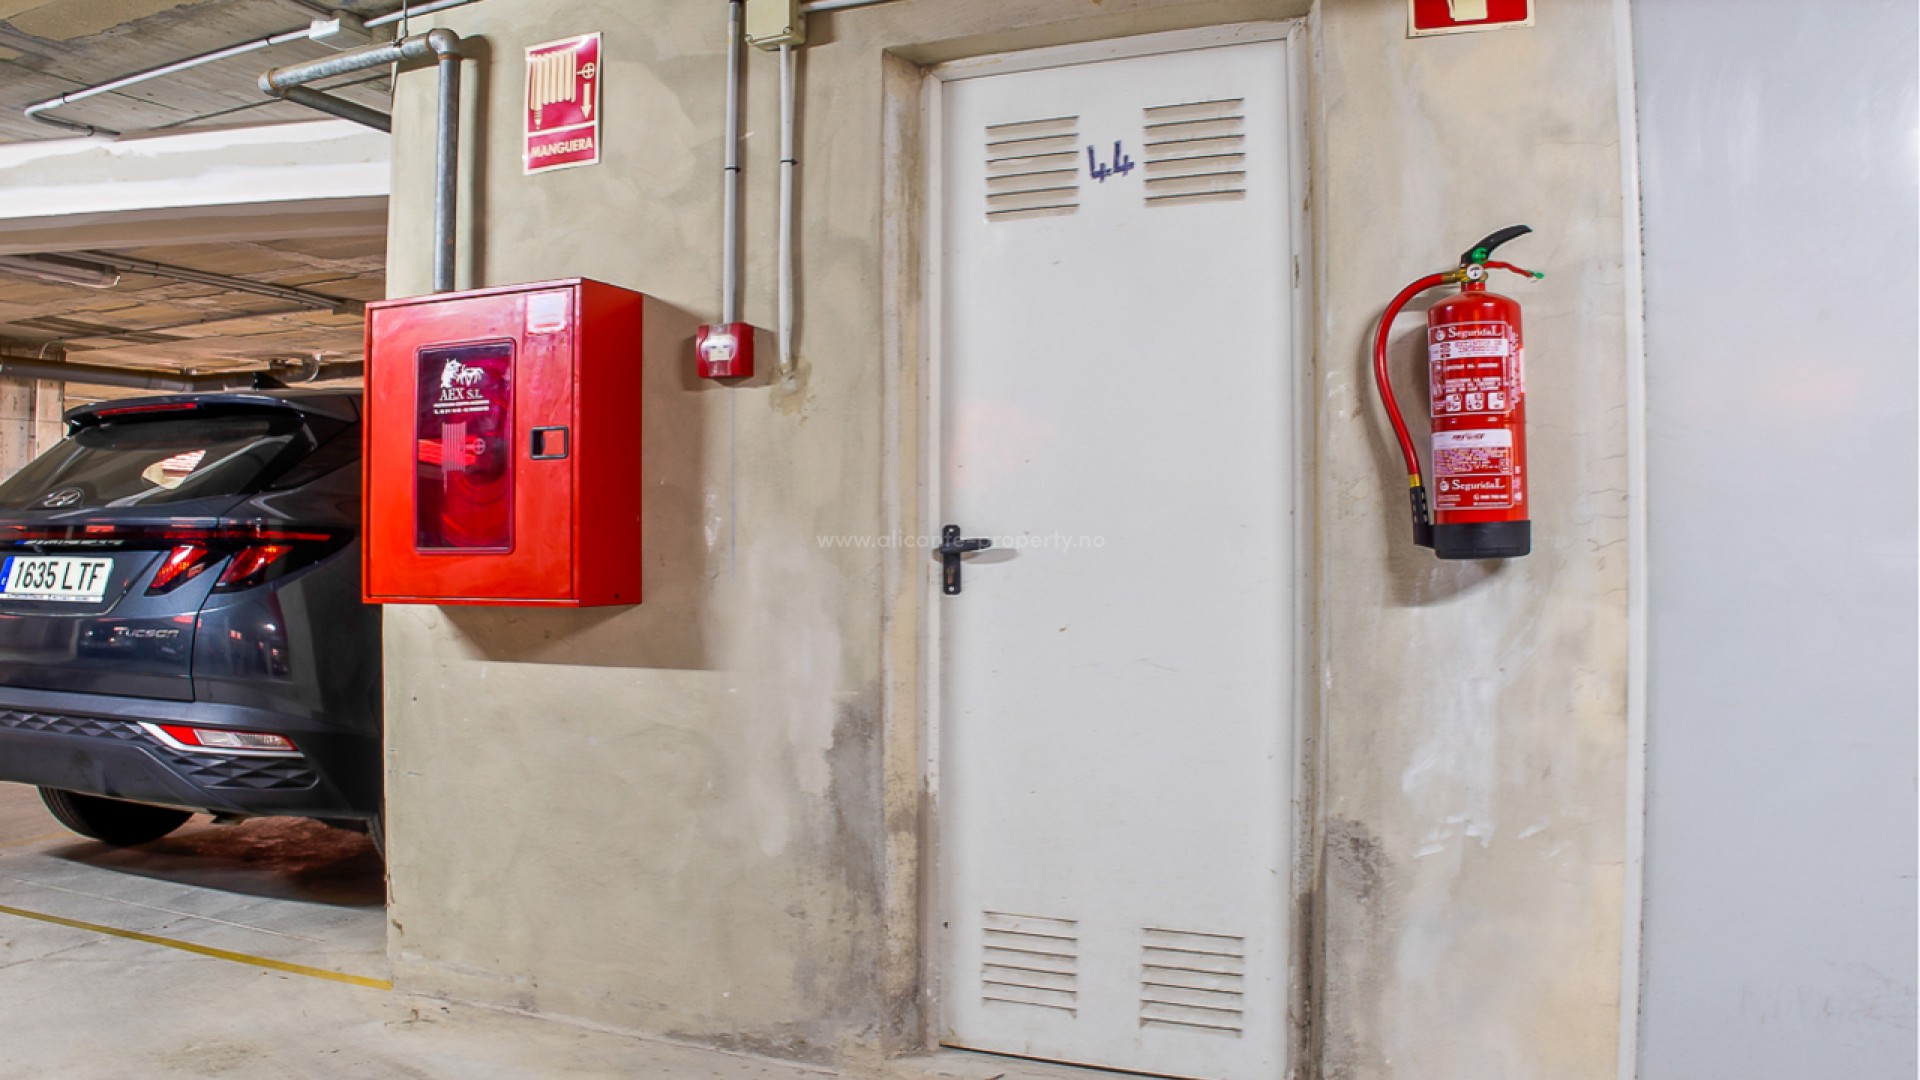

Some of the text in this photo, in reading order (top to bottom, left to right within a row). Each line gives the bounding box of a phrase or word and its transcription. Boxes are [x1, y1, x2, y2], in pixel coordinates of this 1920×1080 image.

[530, 137, 593, 158] MANGUERA
[440, 388, 465, 401] AEX
[1451, 478, 1506, 491] SeguridaL
[14, 561, 105, 591] 1635 LTF
